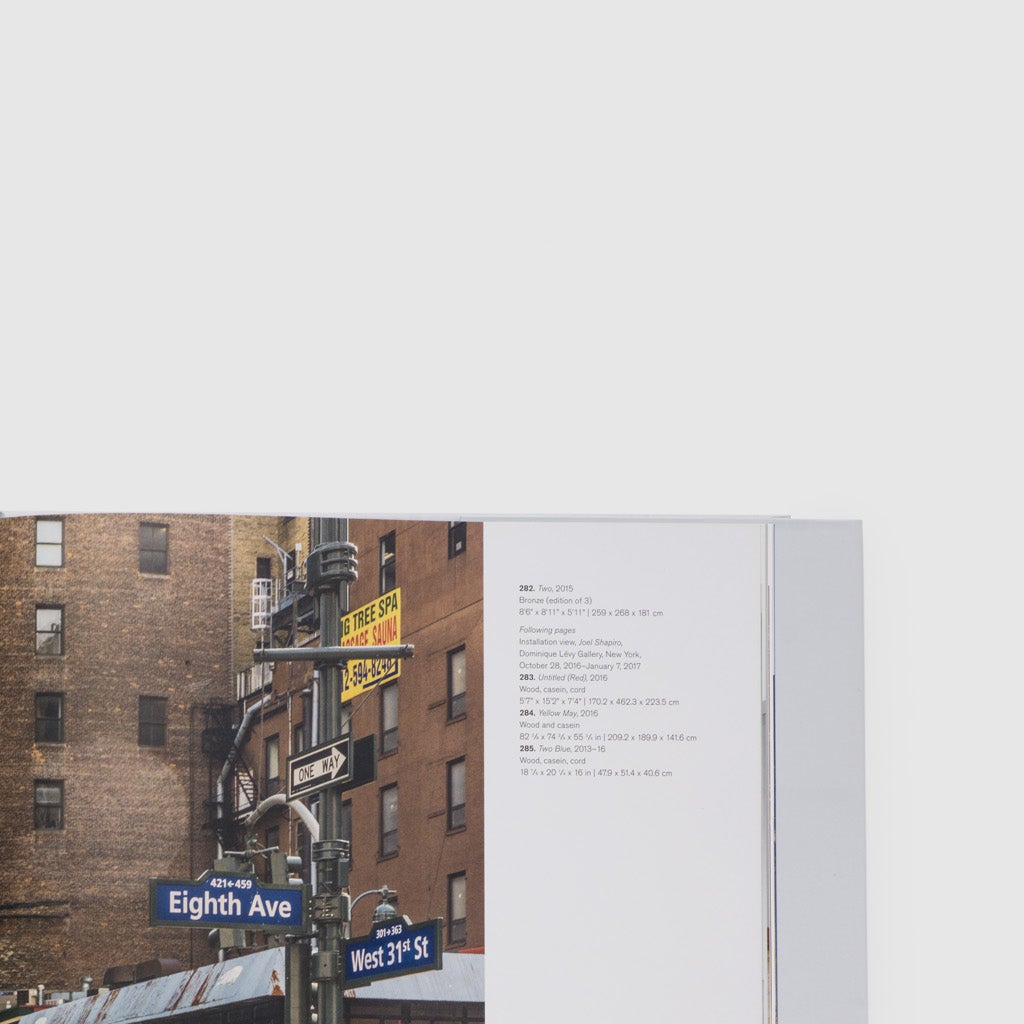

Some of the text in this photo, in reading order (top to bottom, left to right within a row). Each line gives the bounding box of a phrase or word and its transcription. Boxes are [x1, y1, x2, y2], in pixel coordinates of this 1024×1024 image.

[546, 597, 573, 605] (edition
[584, 597, 593, 605] 3)
[353, 603, 376, 632] TREE
[378, 592, 398, 618] SPA
[372, 614, 398, 646] SAUNA
[519, 626, 576, 636] Following pages
[519, 650, 557, 659] Dominique
[559, 650, 576, 659] Lévy
[606, 650, 622, 658] New
[539, 709, 561, 717] Yellow
[542, 721, 556, 729] and
[557, 721, 580, 729] casein
[547, 733, 556, 741] 74
[573, 733, 584, 741] 55
[299, 752, 340, 782] ONE WAY
[169, 890, 292, 920] Eighth Ave
[351, 935, 429, 973] West 31st St
